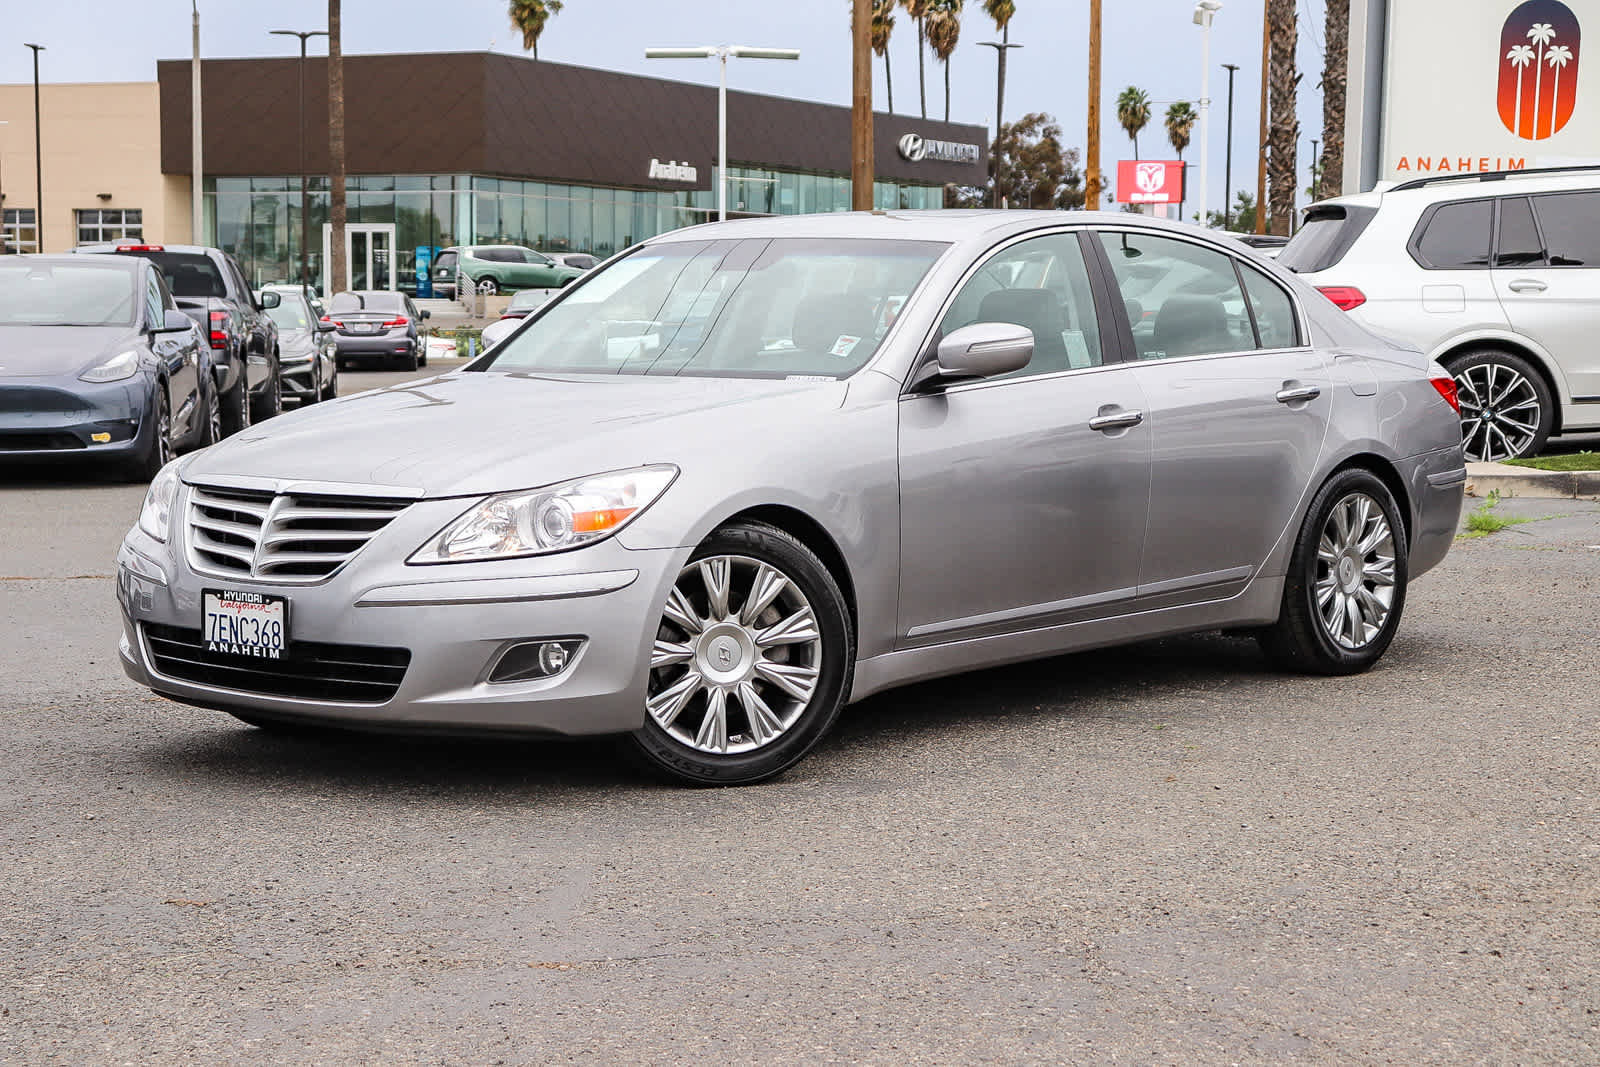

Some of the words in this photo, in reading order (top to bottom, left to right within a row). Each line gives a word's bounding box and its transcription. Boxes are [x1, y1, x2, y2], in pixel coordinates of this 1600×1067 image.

[1397, 156, 1526, 172] ANAHEIM
[224, 591, 262, 603] HYUNDAI
[208, 613, 280, 648] 7ENC368
[209, 642, 279, 658] ANAHEIM
